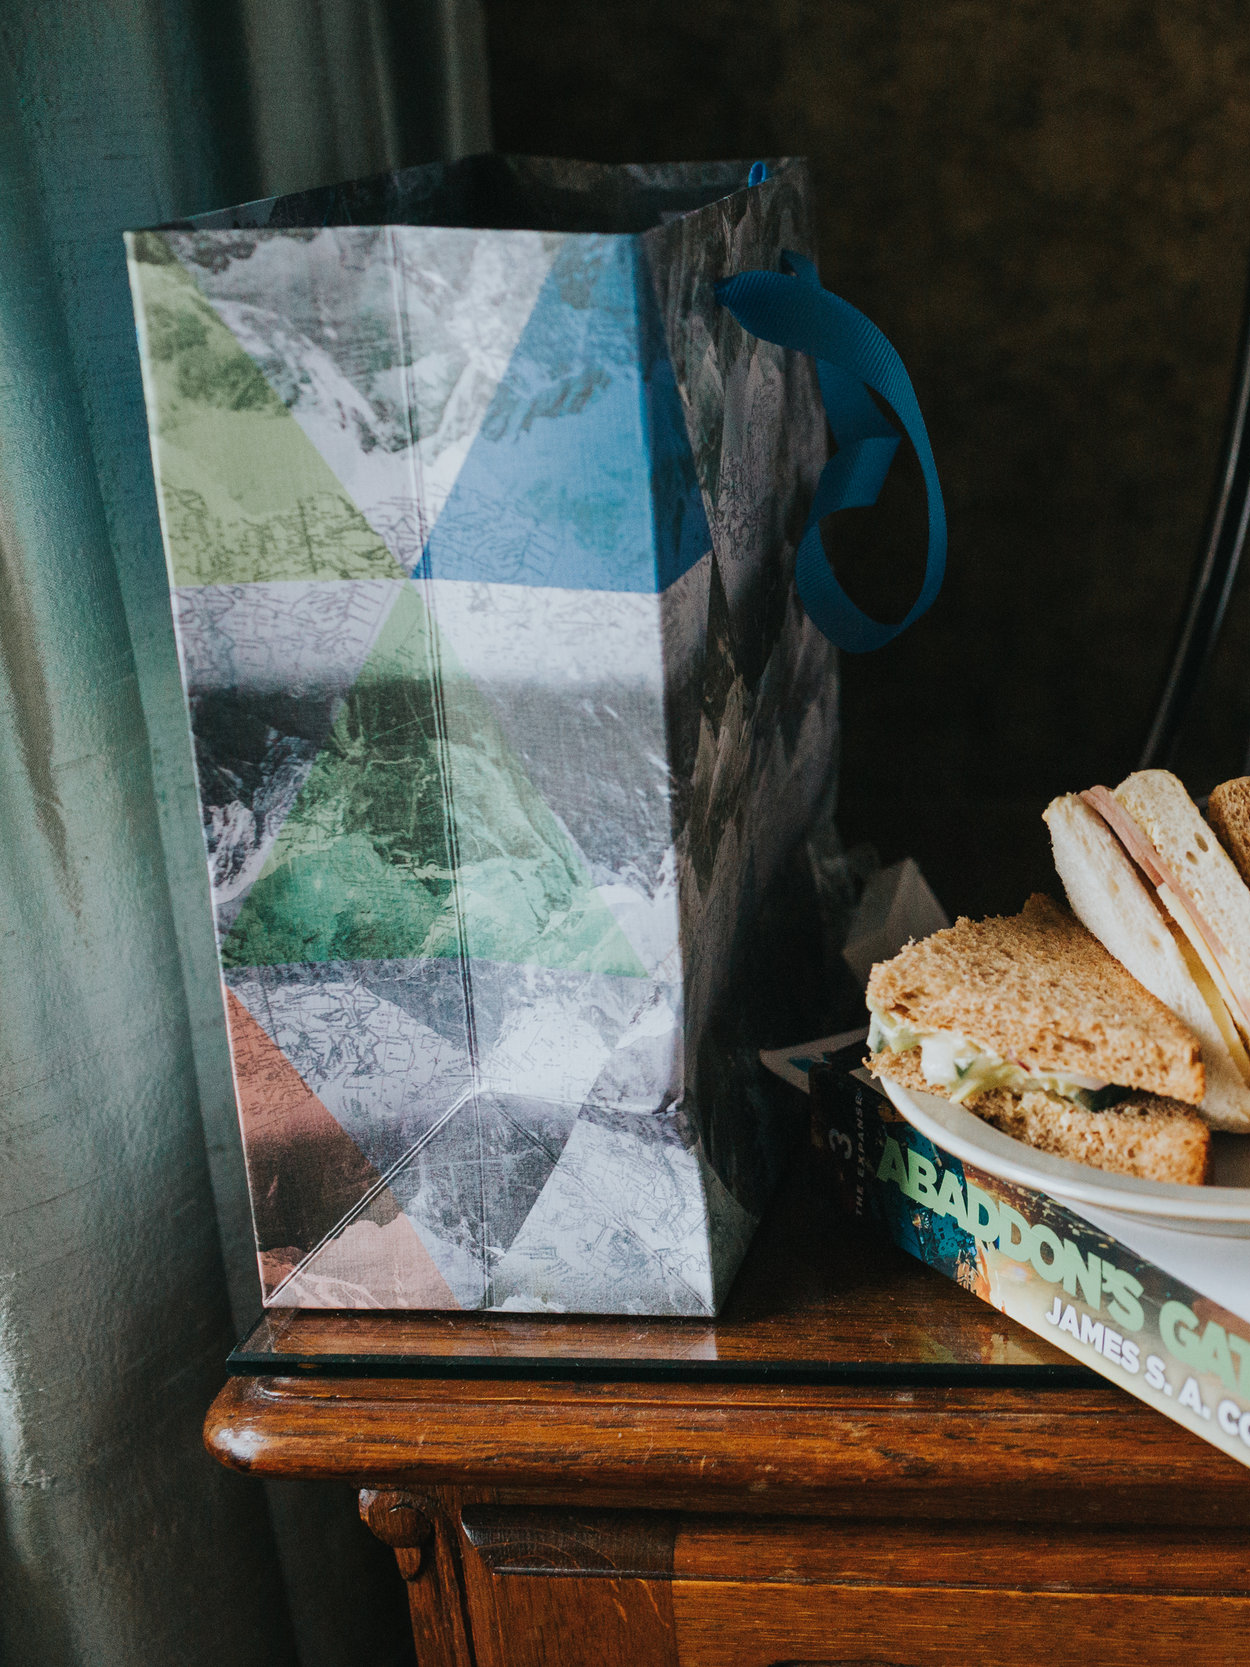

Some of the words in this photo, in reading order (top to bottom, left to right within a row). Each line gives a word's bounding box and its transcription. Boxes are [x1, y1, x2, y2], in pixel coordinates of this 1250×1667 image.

[827, 1128, 853, 1160] 3
[855, 1089, 866, 1178] EXPANSE
[855, 1183, 865, 1217] THE
[876, 1135, 1144, 1332] ABADDON'S
[1045, 1297, 1141, 1375] JAMES
[1143, 1355, 1173, 1397] S.
[1178, 1376, 1212, 1421] A.
